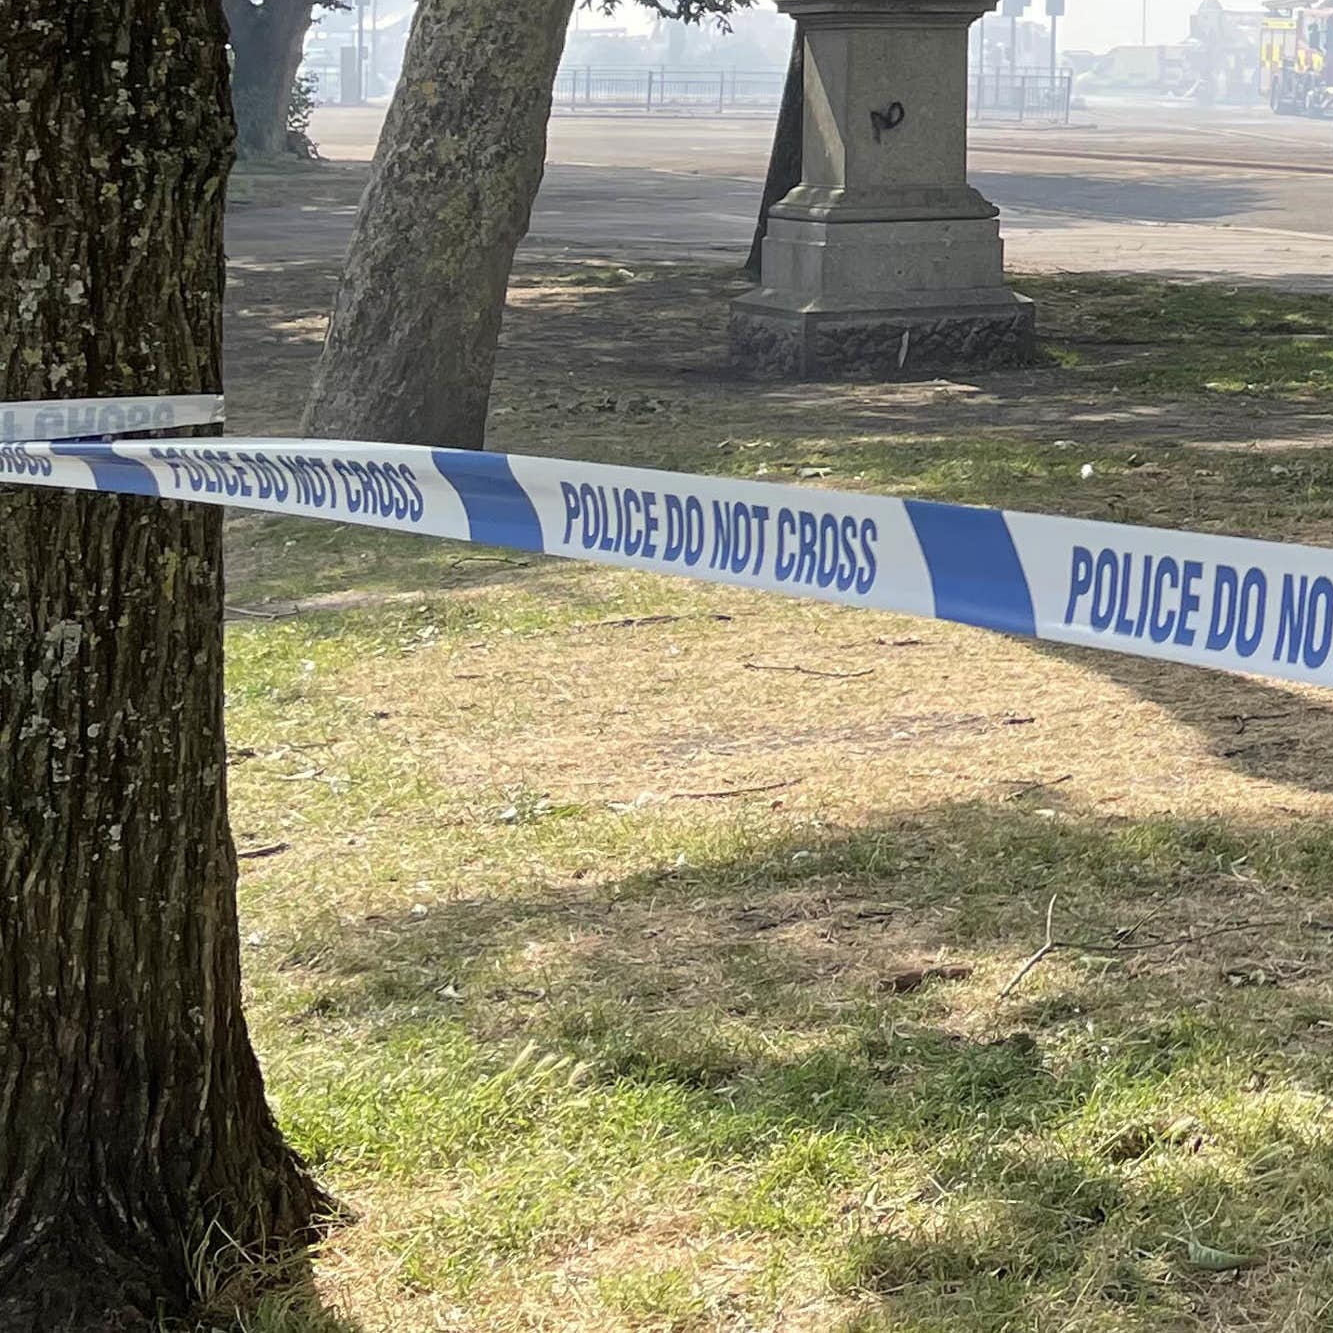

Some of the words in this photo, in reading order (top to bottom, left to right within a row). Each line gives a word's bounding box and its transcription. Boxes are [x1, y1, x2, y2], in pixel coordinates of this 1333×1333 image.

[151, 447, 252, 497] POLICE
[237, 452, 289, 503] DO
[277, 455, 337, 509] NOT
[331, 458, 424, 523] CROSS
[560, 480, 659, 558] POLICE
[663, 494, 705, 566] DO
[709, 500, 769, 576] NOT
[775, 507, 878, 595] CROSS
[1064, 545, 1203, 646] POLICE
[1205, 564, 1267, 657] DO
